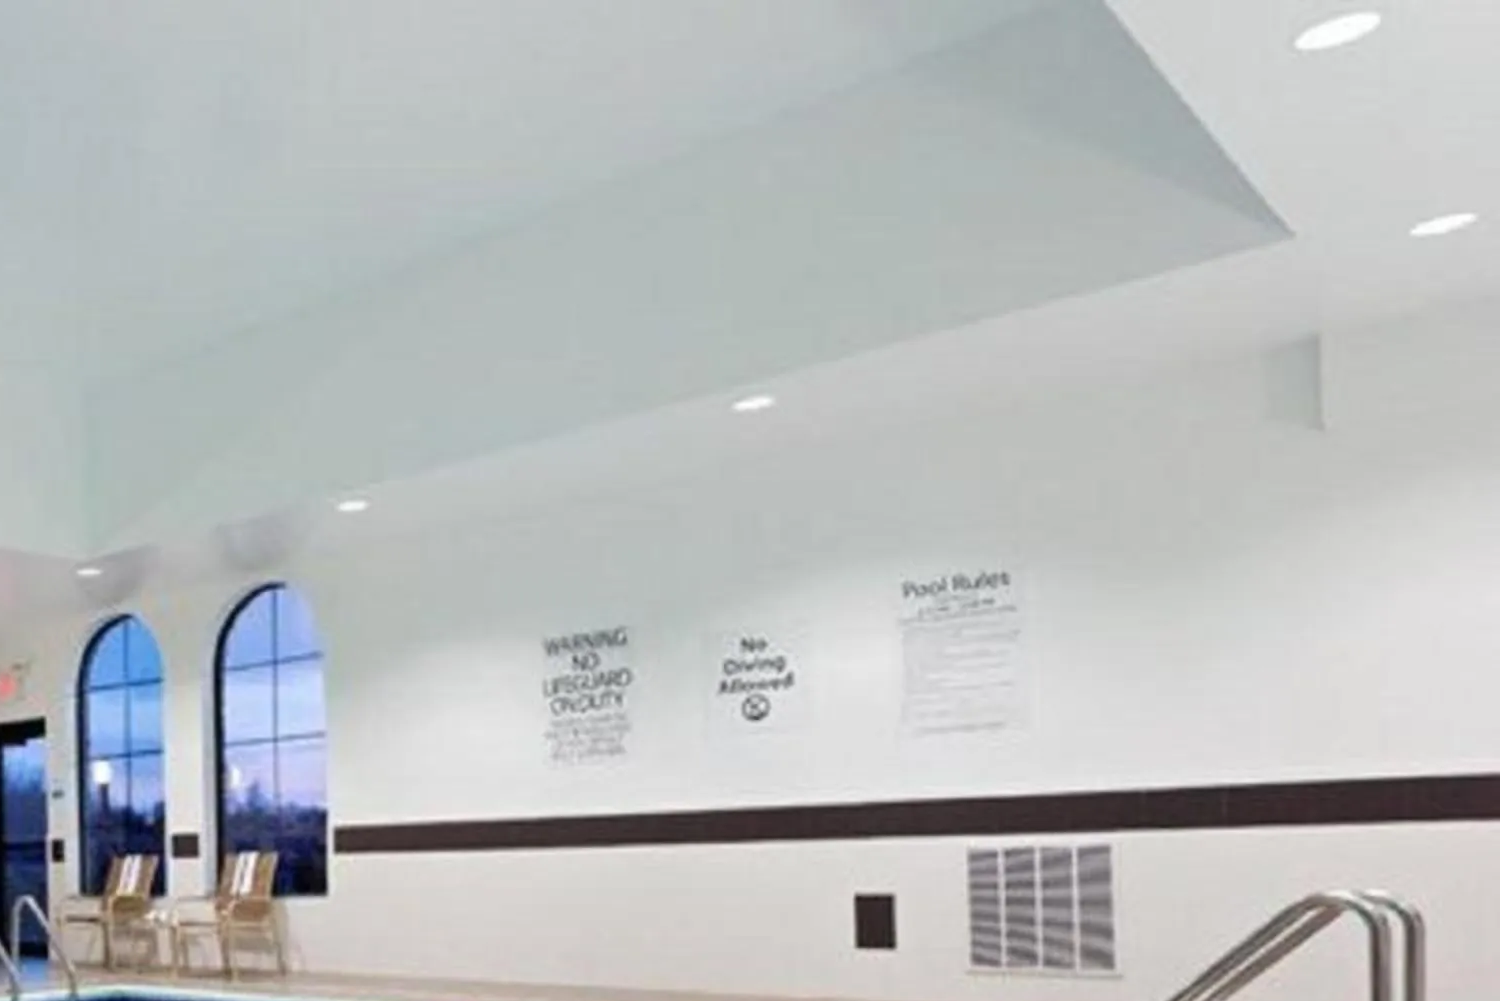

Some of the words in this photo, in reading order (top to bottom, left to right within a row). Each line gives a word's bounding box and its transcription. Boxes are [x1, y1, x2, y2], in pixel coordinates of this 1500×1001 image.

[902, 577, 947, 599] Pool
[951, 570, 1011, 592] Rules
[542, 625, 629, 656] WARNING
[571, 651, 601, 672] NO
